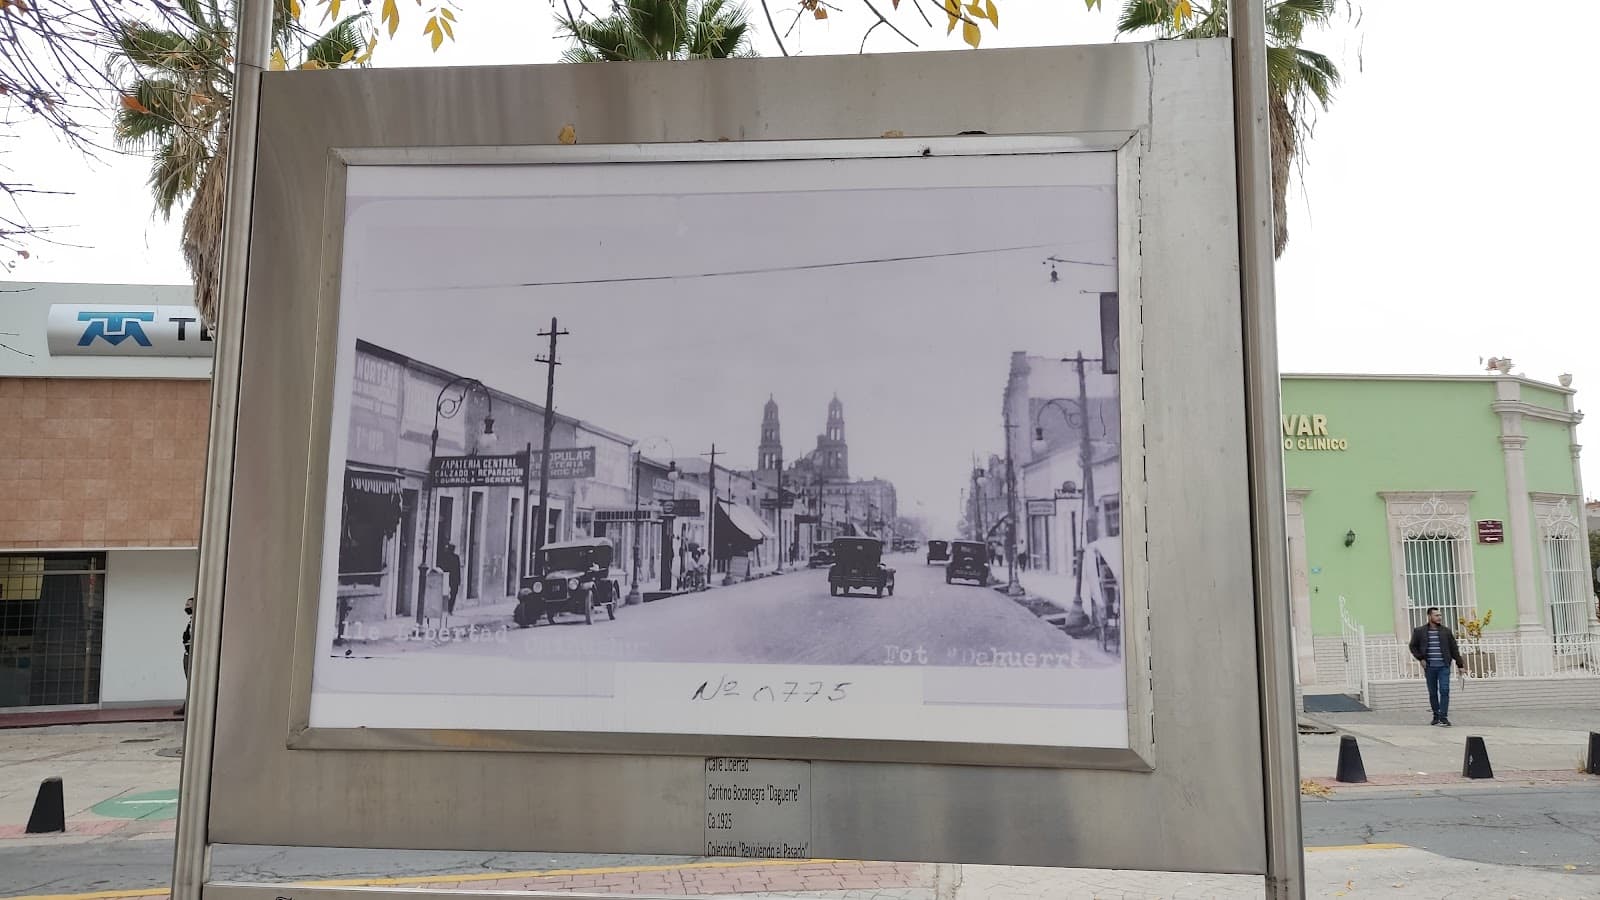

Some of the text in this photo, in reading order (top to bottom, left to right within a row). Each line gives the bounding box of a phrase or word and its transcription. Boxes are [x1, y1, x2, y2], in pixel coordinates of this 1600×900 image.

[1297, 438, 1348, 451] CLINICO
[440, 458, 481, 470] ZAPATERIA
[482, 457, 519, 470] CENTRAL
[394, 621, 510, 643] Libertad
[733, 783, 765, 805] Bocanegra
